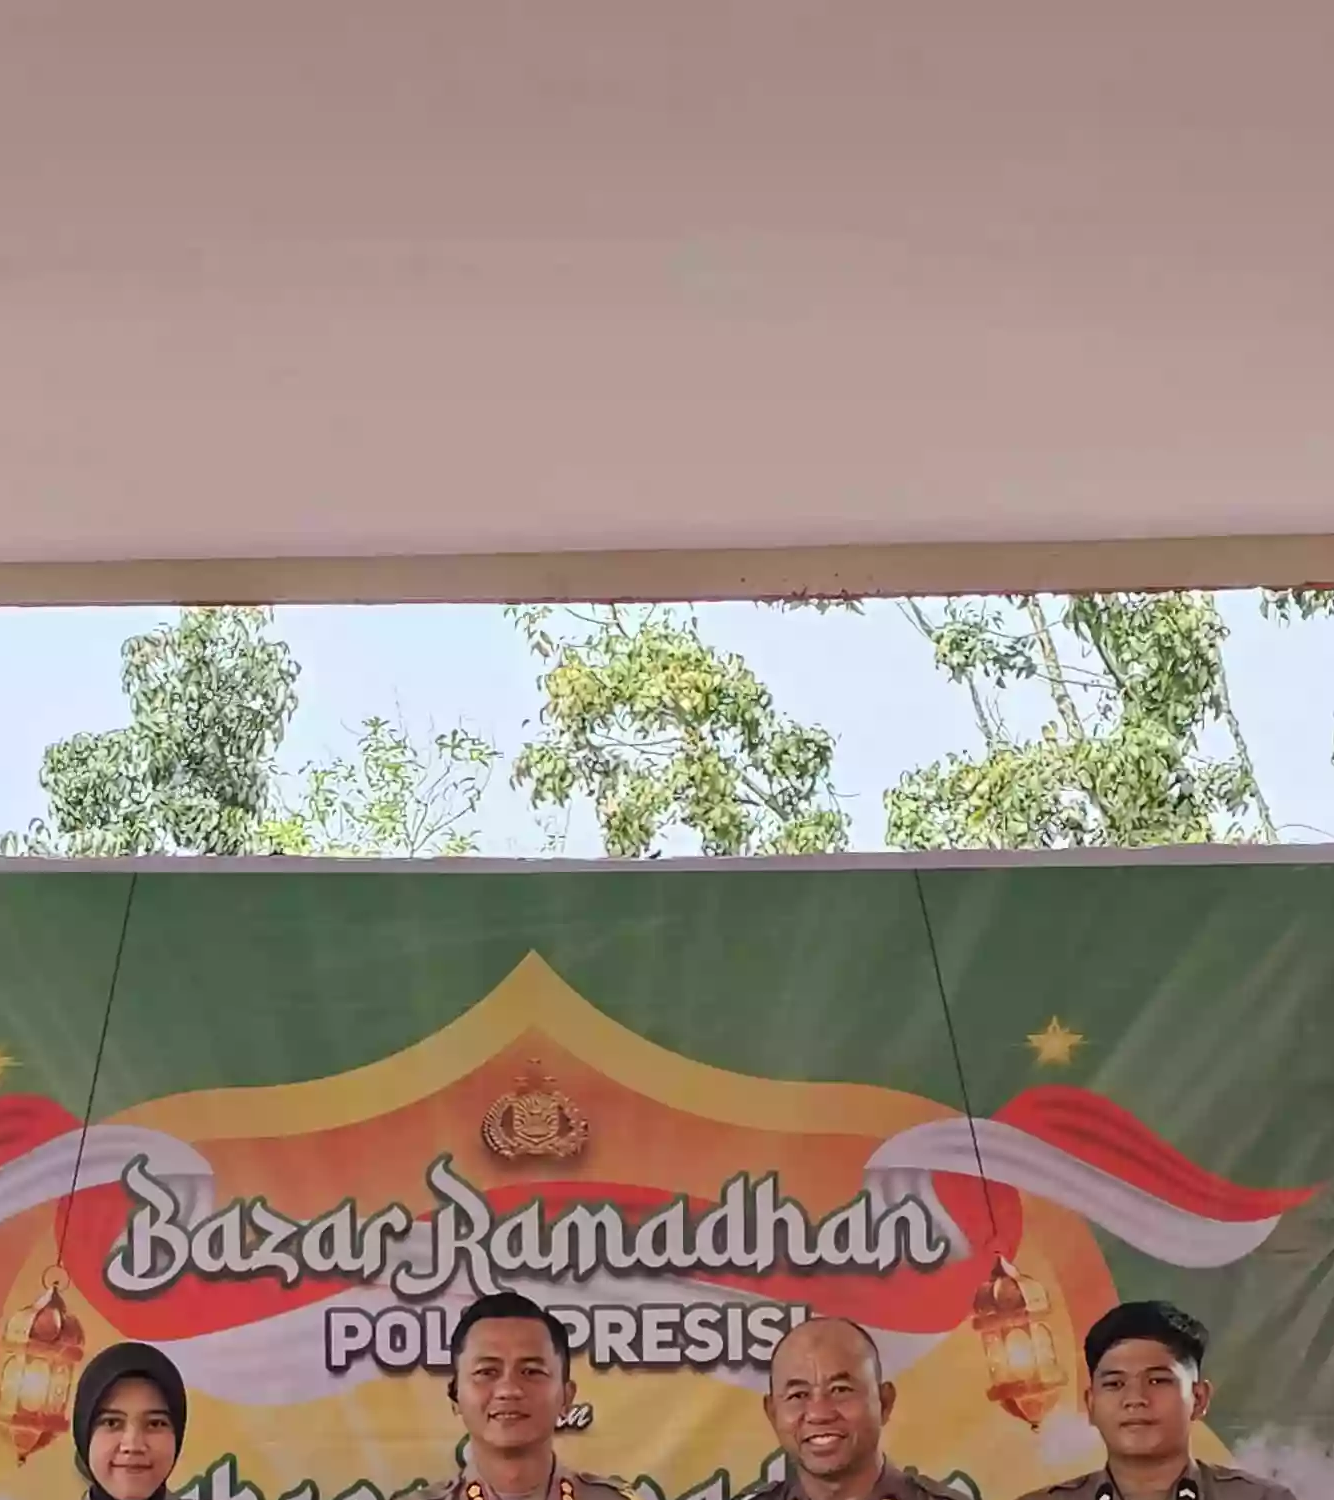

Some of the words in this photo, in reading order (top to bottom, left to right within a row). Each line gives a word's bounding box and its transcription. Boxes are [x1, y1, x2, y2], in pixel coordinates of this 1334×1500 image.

[106, 1156, 412, 1294] Bazar
[392, 1156, 950, 1300] Ramadhan
[328, 1309, 453, 1369] POL
[557, 1306, 807, 1364] PRESIS
